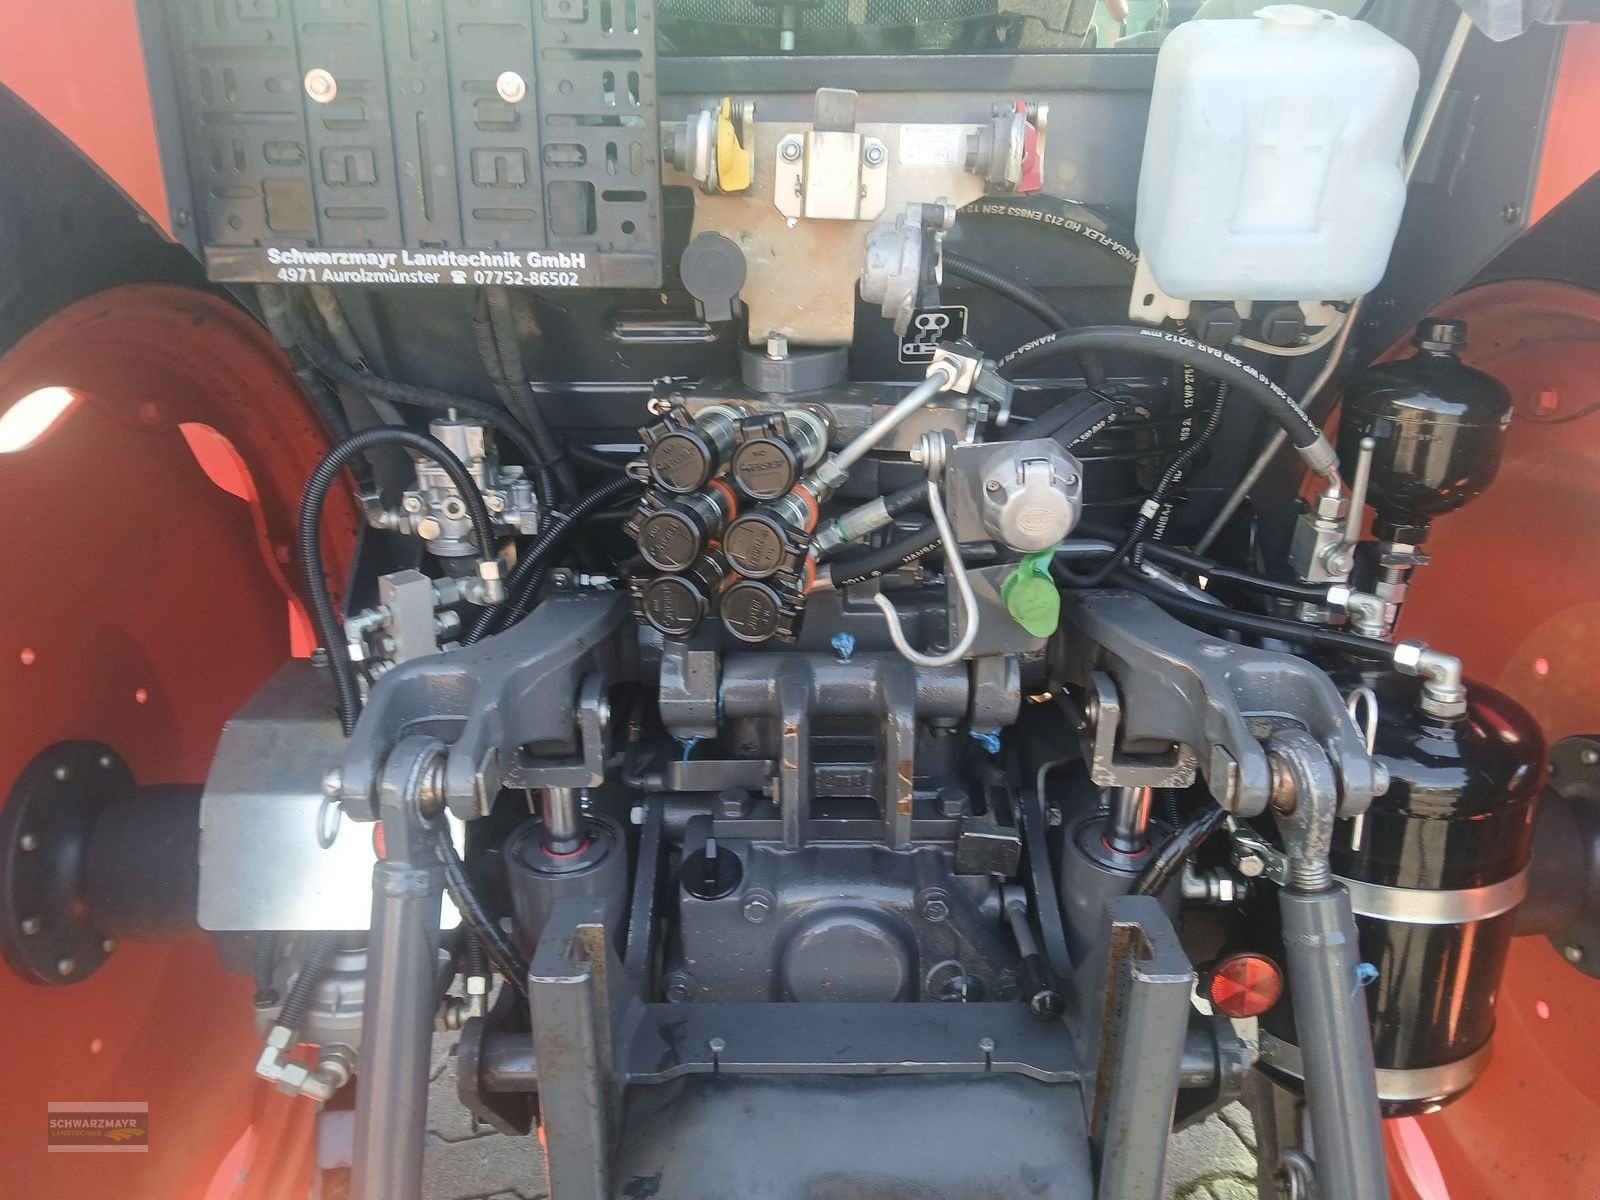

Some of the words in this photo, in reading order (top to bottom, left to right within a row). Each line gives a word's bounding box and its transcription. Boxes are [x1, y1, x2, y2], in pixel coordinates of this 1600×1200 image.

[982, 204, 1006, 215] 2SN
[1044, 214, 1064, 226] 213
[1064, 220, 1082, 233] HD
[266, 248, 398, 269] Schwarzmayr
[401, 249, 523, 268] Landtechnik
[526, 251, 586, 269] GmbH
[277, 267, 317, 282] 4971
[322, 267, 440, 284] Aurolzmünster
[473, 270, 579, 287] 07752-86502
[1197, 342, 1222, 358] BAR
